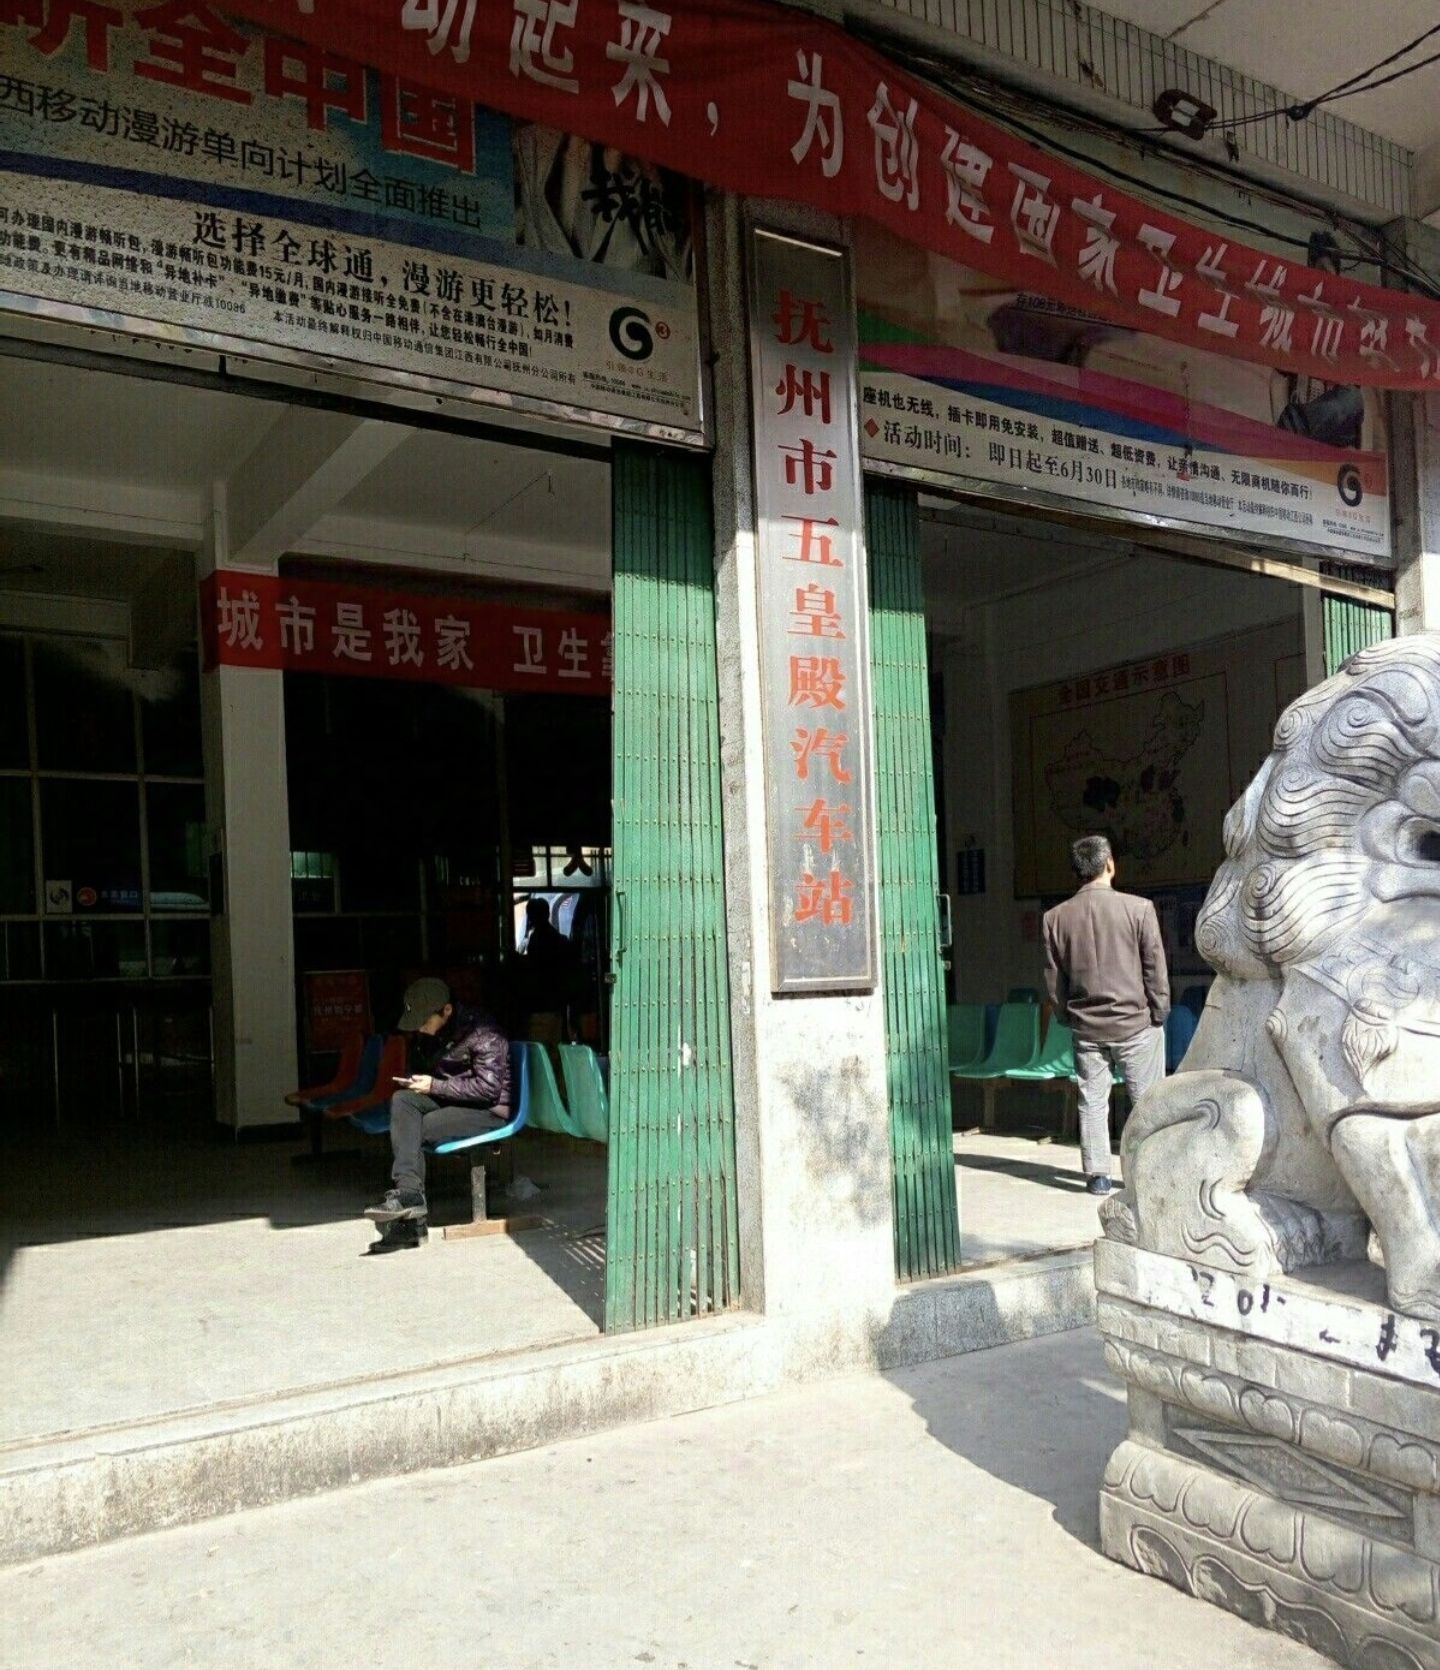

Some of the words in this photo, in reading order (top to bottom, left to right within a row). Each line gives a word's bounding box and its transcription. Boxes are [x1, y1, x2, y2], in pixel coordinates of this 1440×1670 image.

[217, 585, 475, 671] 城市是我家
[773, 288, 854, 928] 抚州市五皇殿汽车站
